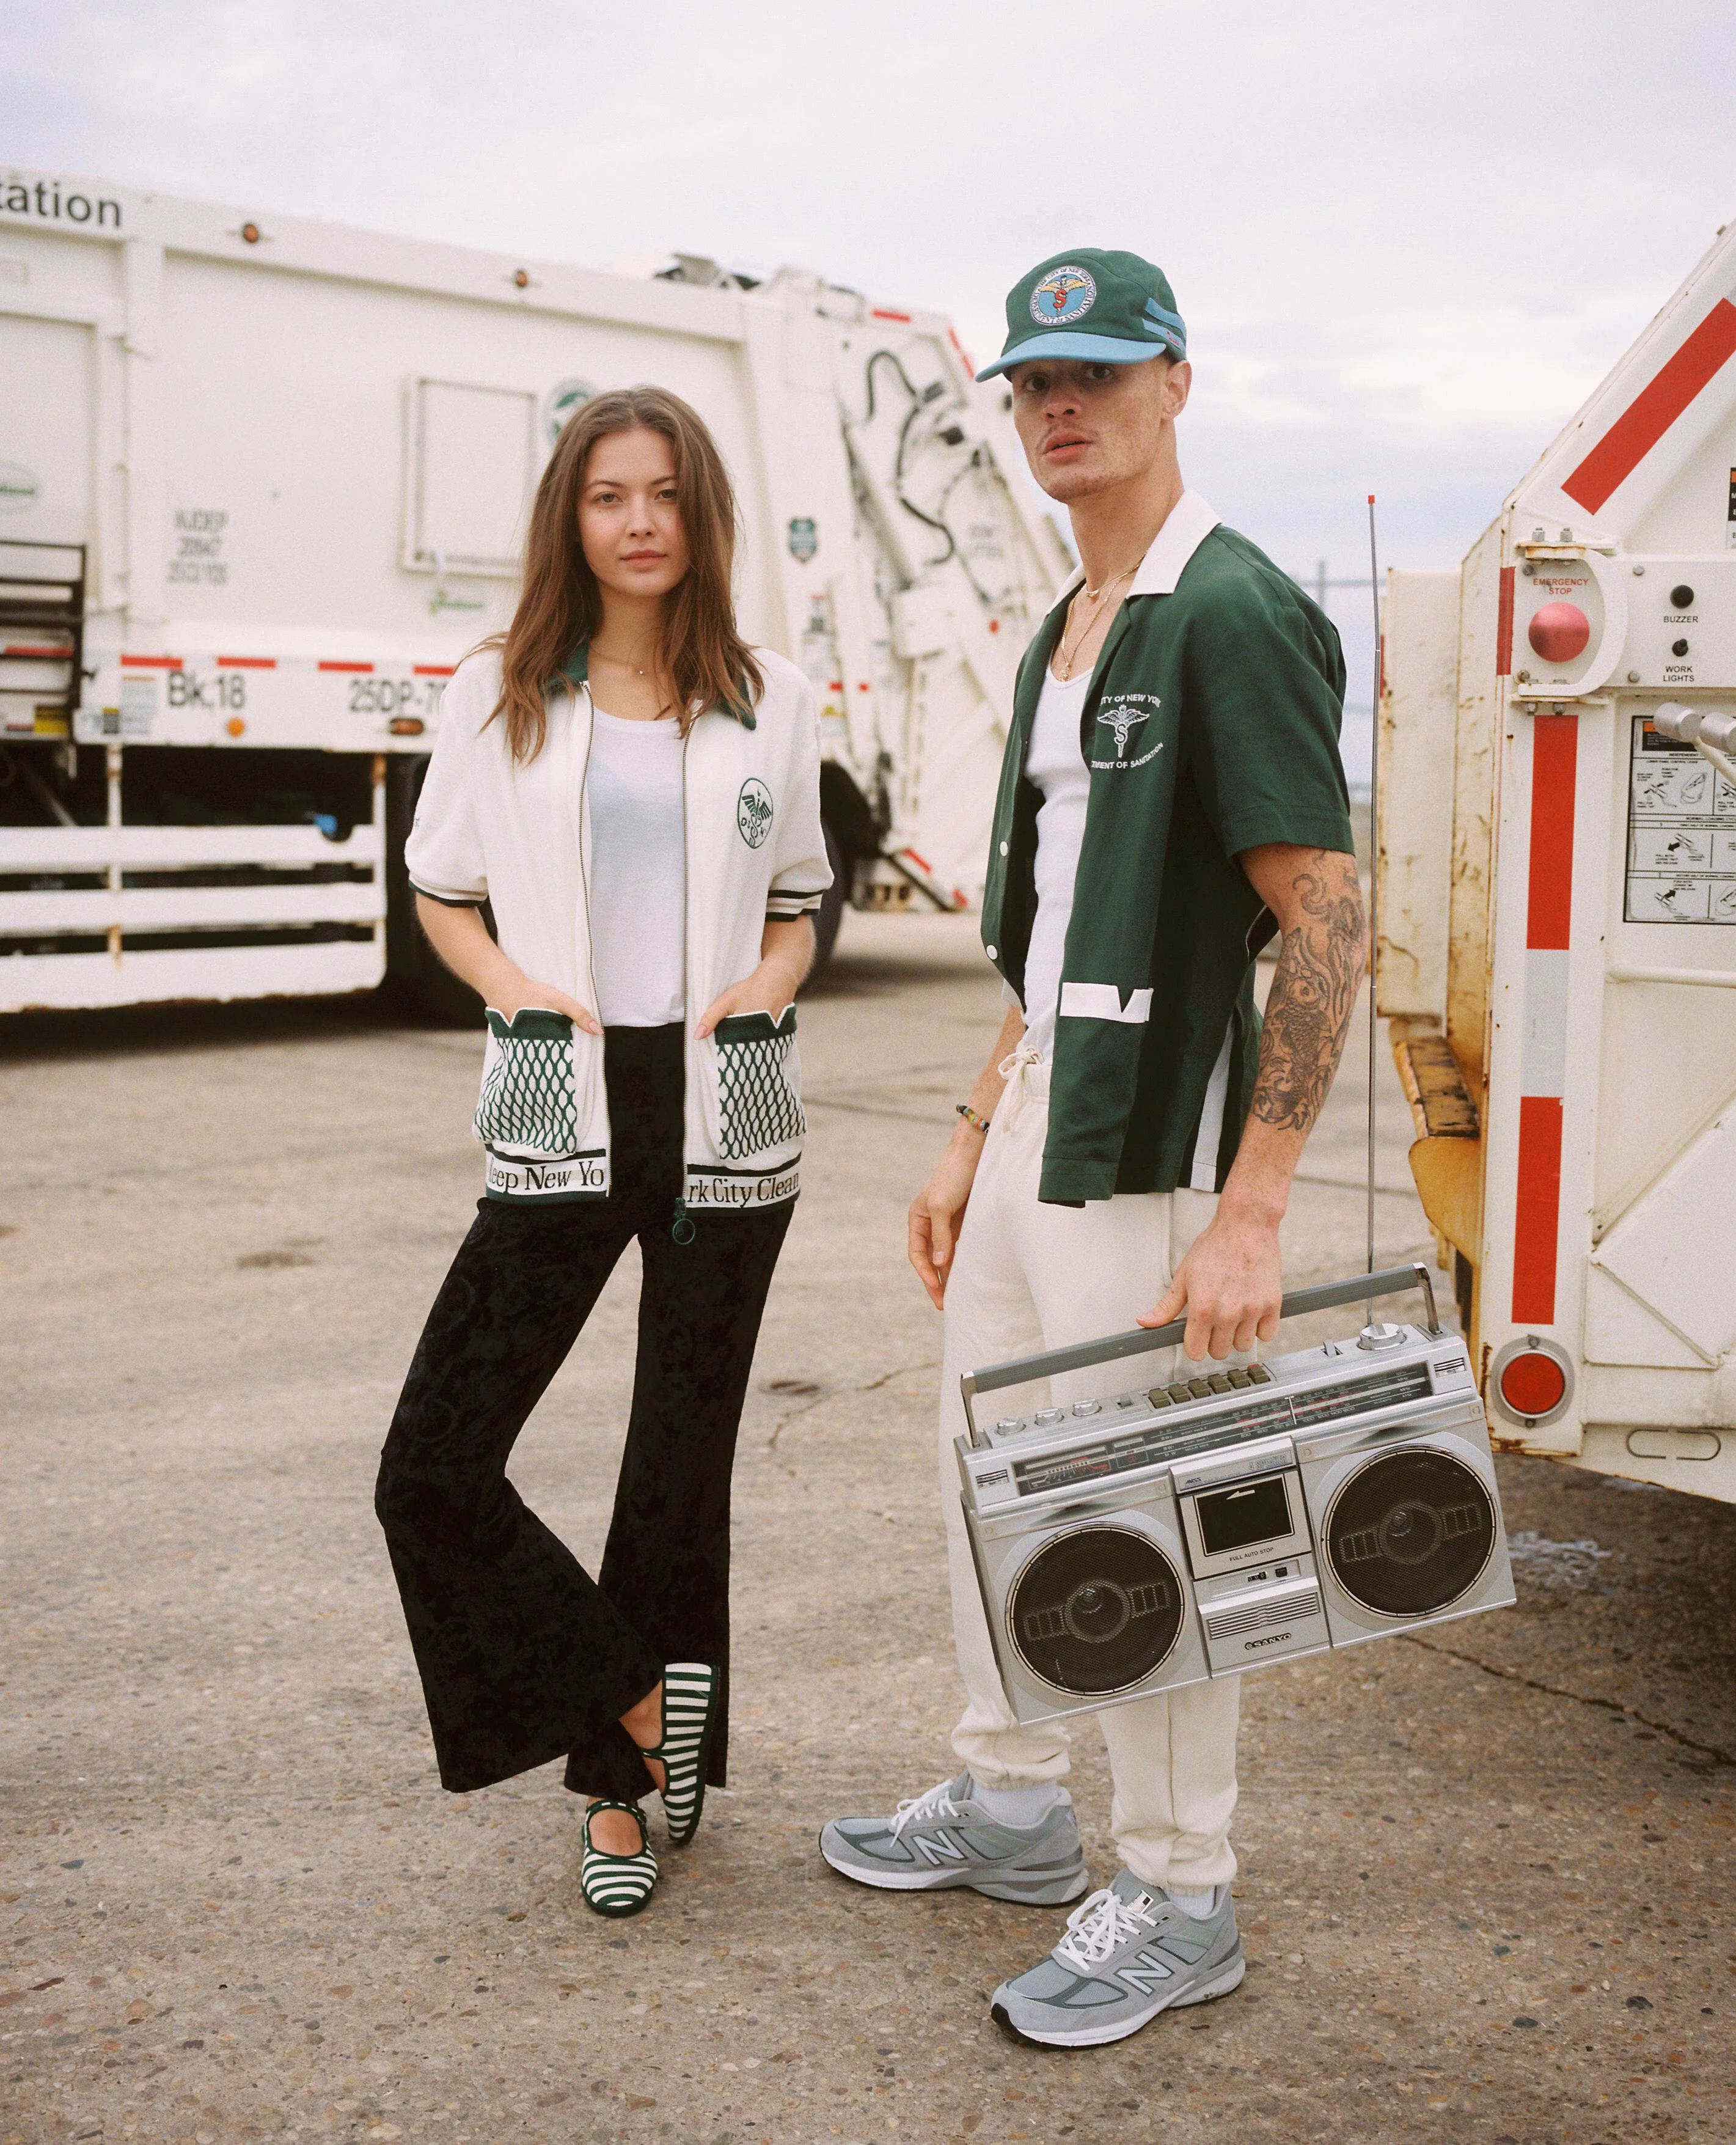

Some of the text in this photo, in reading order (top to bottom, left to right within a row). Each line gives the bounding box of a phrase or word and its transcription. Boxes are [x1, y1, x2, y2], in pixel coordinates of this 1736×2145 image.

[0, 182, 121, 227] ation
[1053, 289, 1066, 308] S
[1533, 578, 1589, 586] EMERGENCY
[1101, 695, 1112, 705] ITY
[1126, 694, 1146, 702] NEW
[1130, 742, 1163, 768] SANITATION
[524, 1165, 572, 1190] New
[579, 1160, 604, 1186] Yo
[687, 1172, 799, 1209] rk City Clean
[1253, 1632, 1292, 1648] SANYO
[913, 1830, 966, 1866] N
[1115, 1951, 1173, 1996] N
